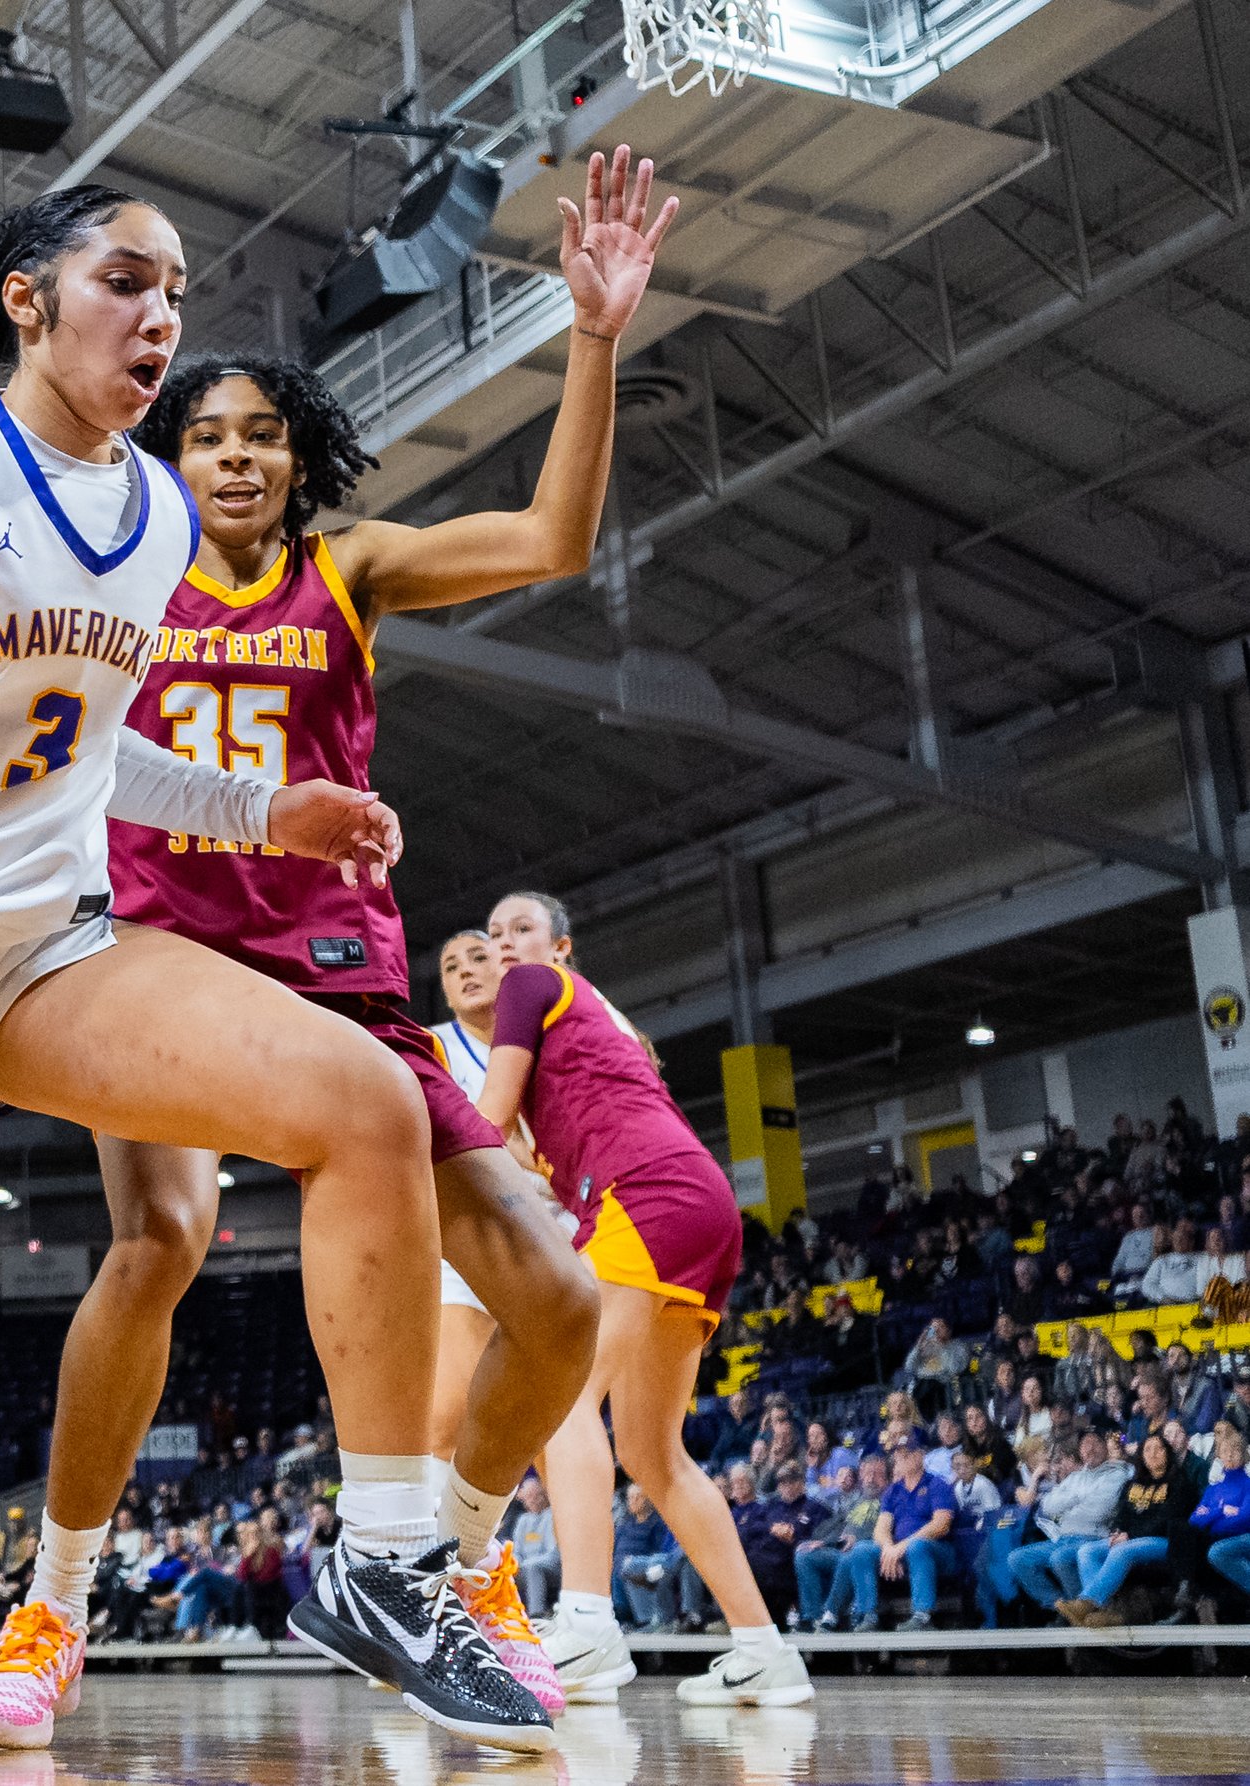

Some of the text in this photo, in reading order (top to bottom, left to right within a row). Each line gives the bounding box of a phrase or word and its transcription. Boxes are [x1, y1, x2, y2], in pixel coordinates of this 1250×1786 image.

[150, 625, 328, 672] ORTHERN
[1, 686, 87, 791] 3
[160, 681, 291, 787] 35
[348, 945, 360, 957] M
